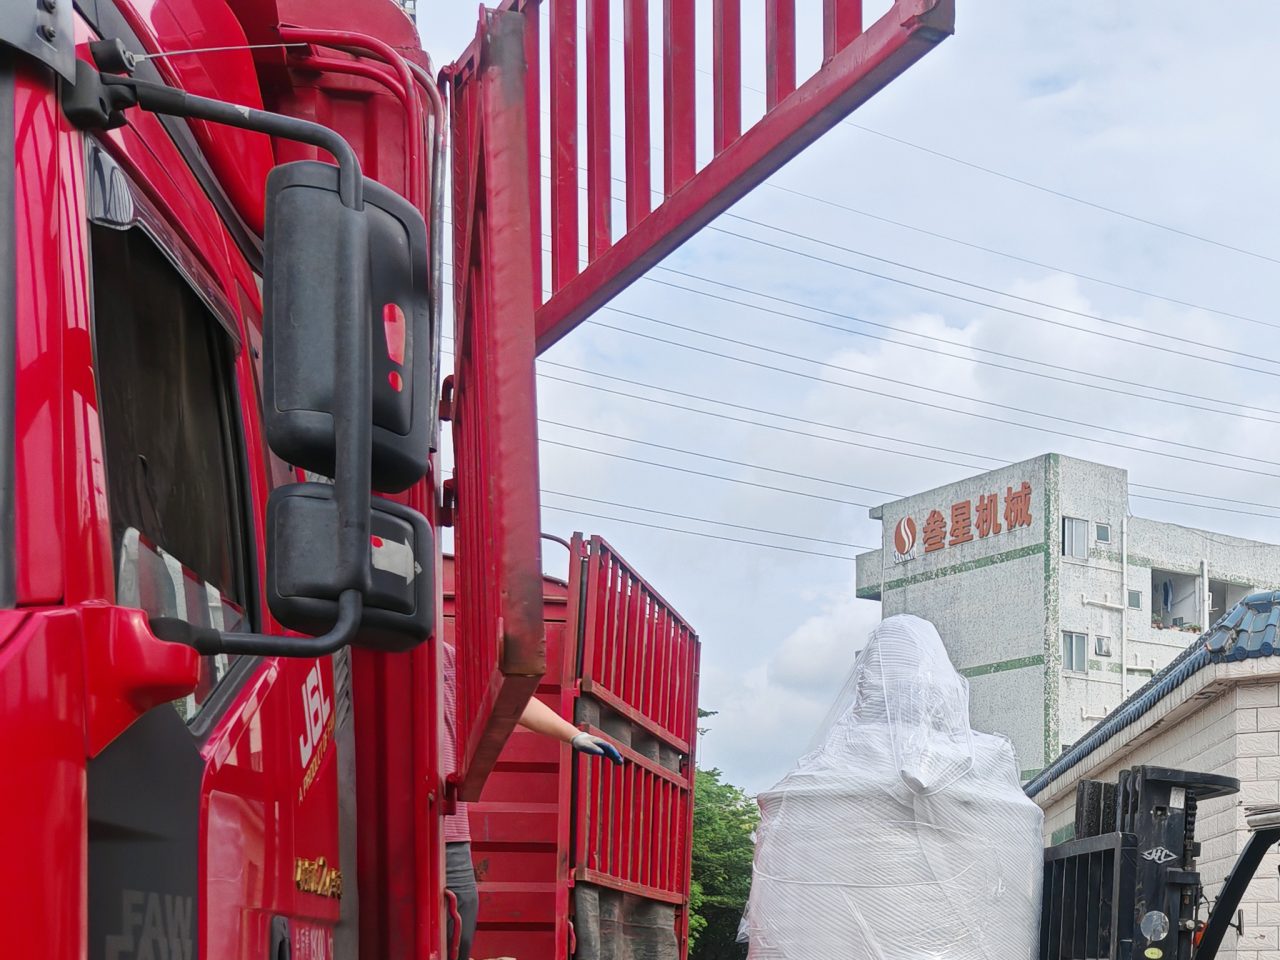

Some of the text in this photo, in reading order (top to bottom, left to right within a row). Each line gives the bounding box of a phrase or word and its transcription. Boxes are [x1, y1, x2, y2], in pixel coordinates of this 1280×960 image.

[922, 480, 1033, 553] 叁星机械
[299, 658, 331, 769] J6L
[122, 888, 193, 939] FAW
